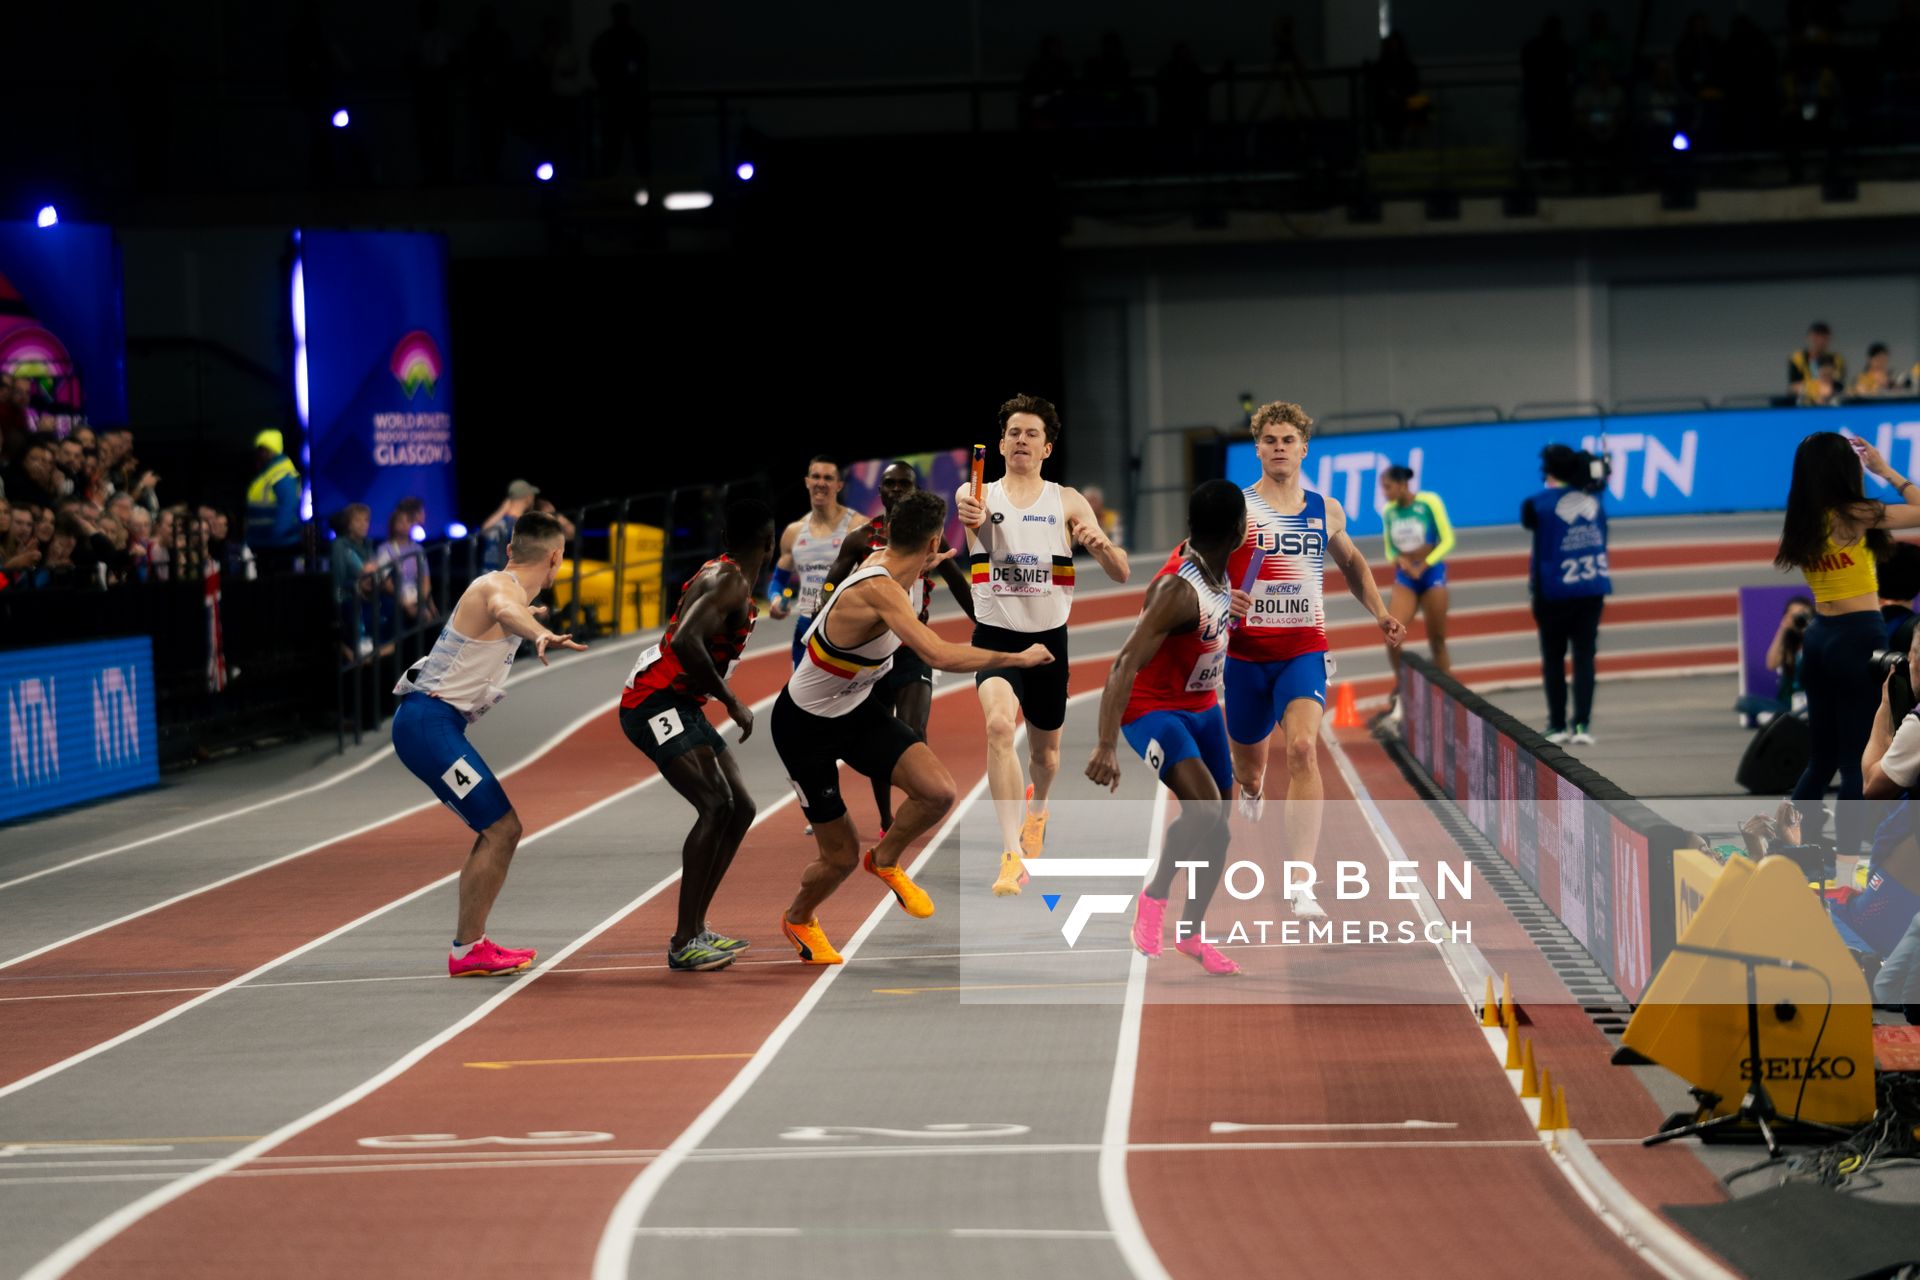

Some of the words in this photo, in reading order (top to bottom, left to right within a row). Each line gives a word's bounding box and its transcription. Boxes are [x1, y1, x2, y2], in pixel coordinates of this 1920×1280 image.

[374, 412, 415, 429] WORLD
[374, 444, 443, 466] GLASGOW
[1022, 515, 1047, 523] Allianz
[1257, 532, 1323, 556] USA
[993, 568, 1010, 581] DE
[1013, 568, 1049, 583] SMET
[1004, 585, 1041, 594] GLASGOW
[1255, 599, 1309, 614] BOLING
[1265, 615, 1304, 625] GLASGOW
[659, 716, 673, 736] 3
[454, 768, 474, 788] 4
[1740, 1056, 1856, 1081] SEIKO
